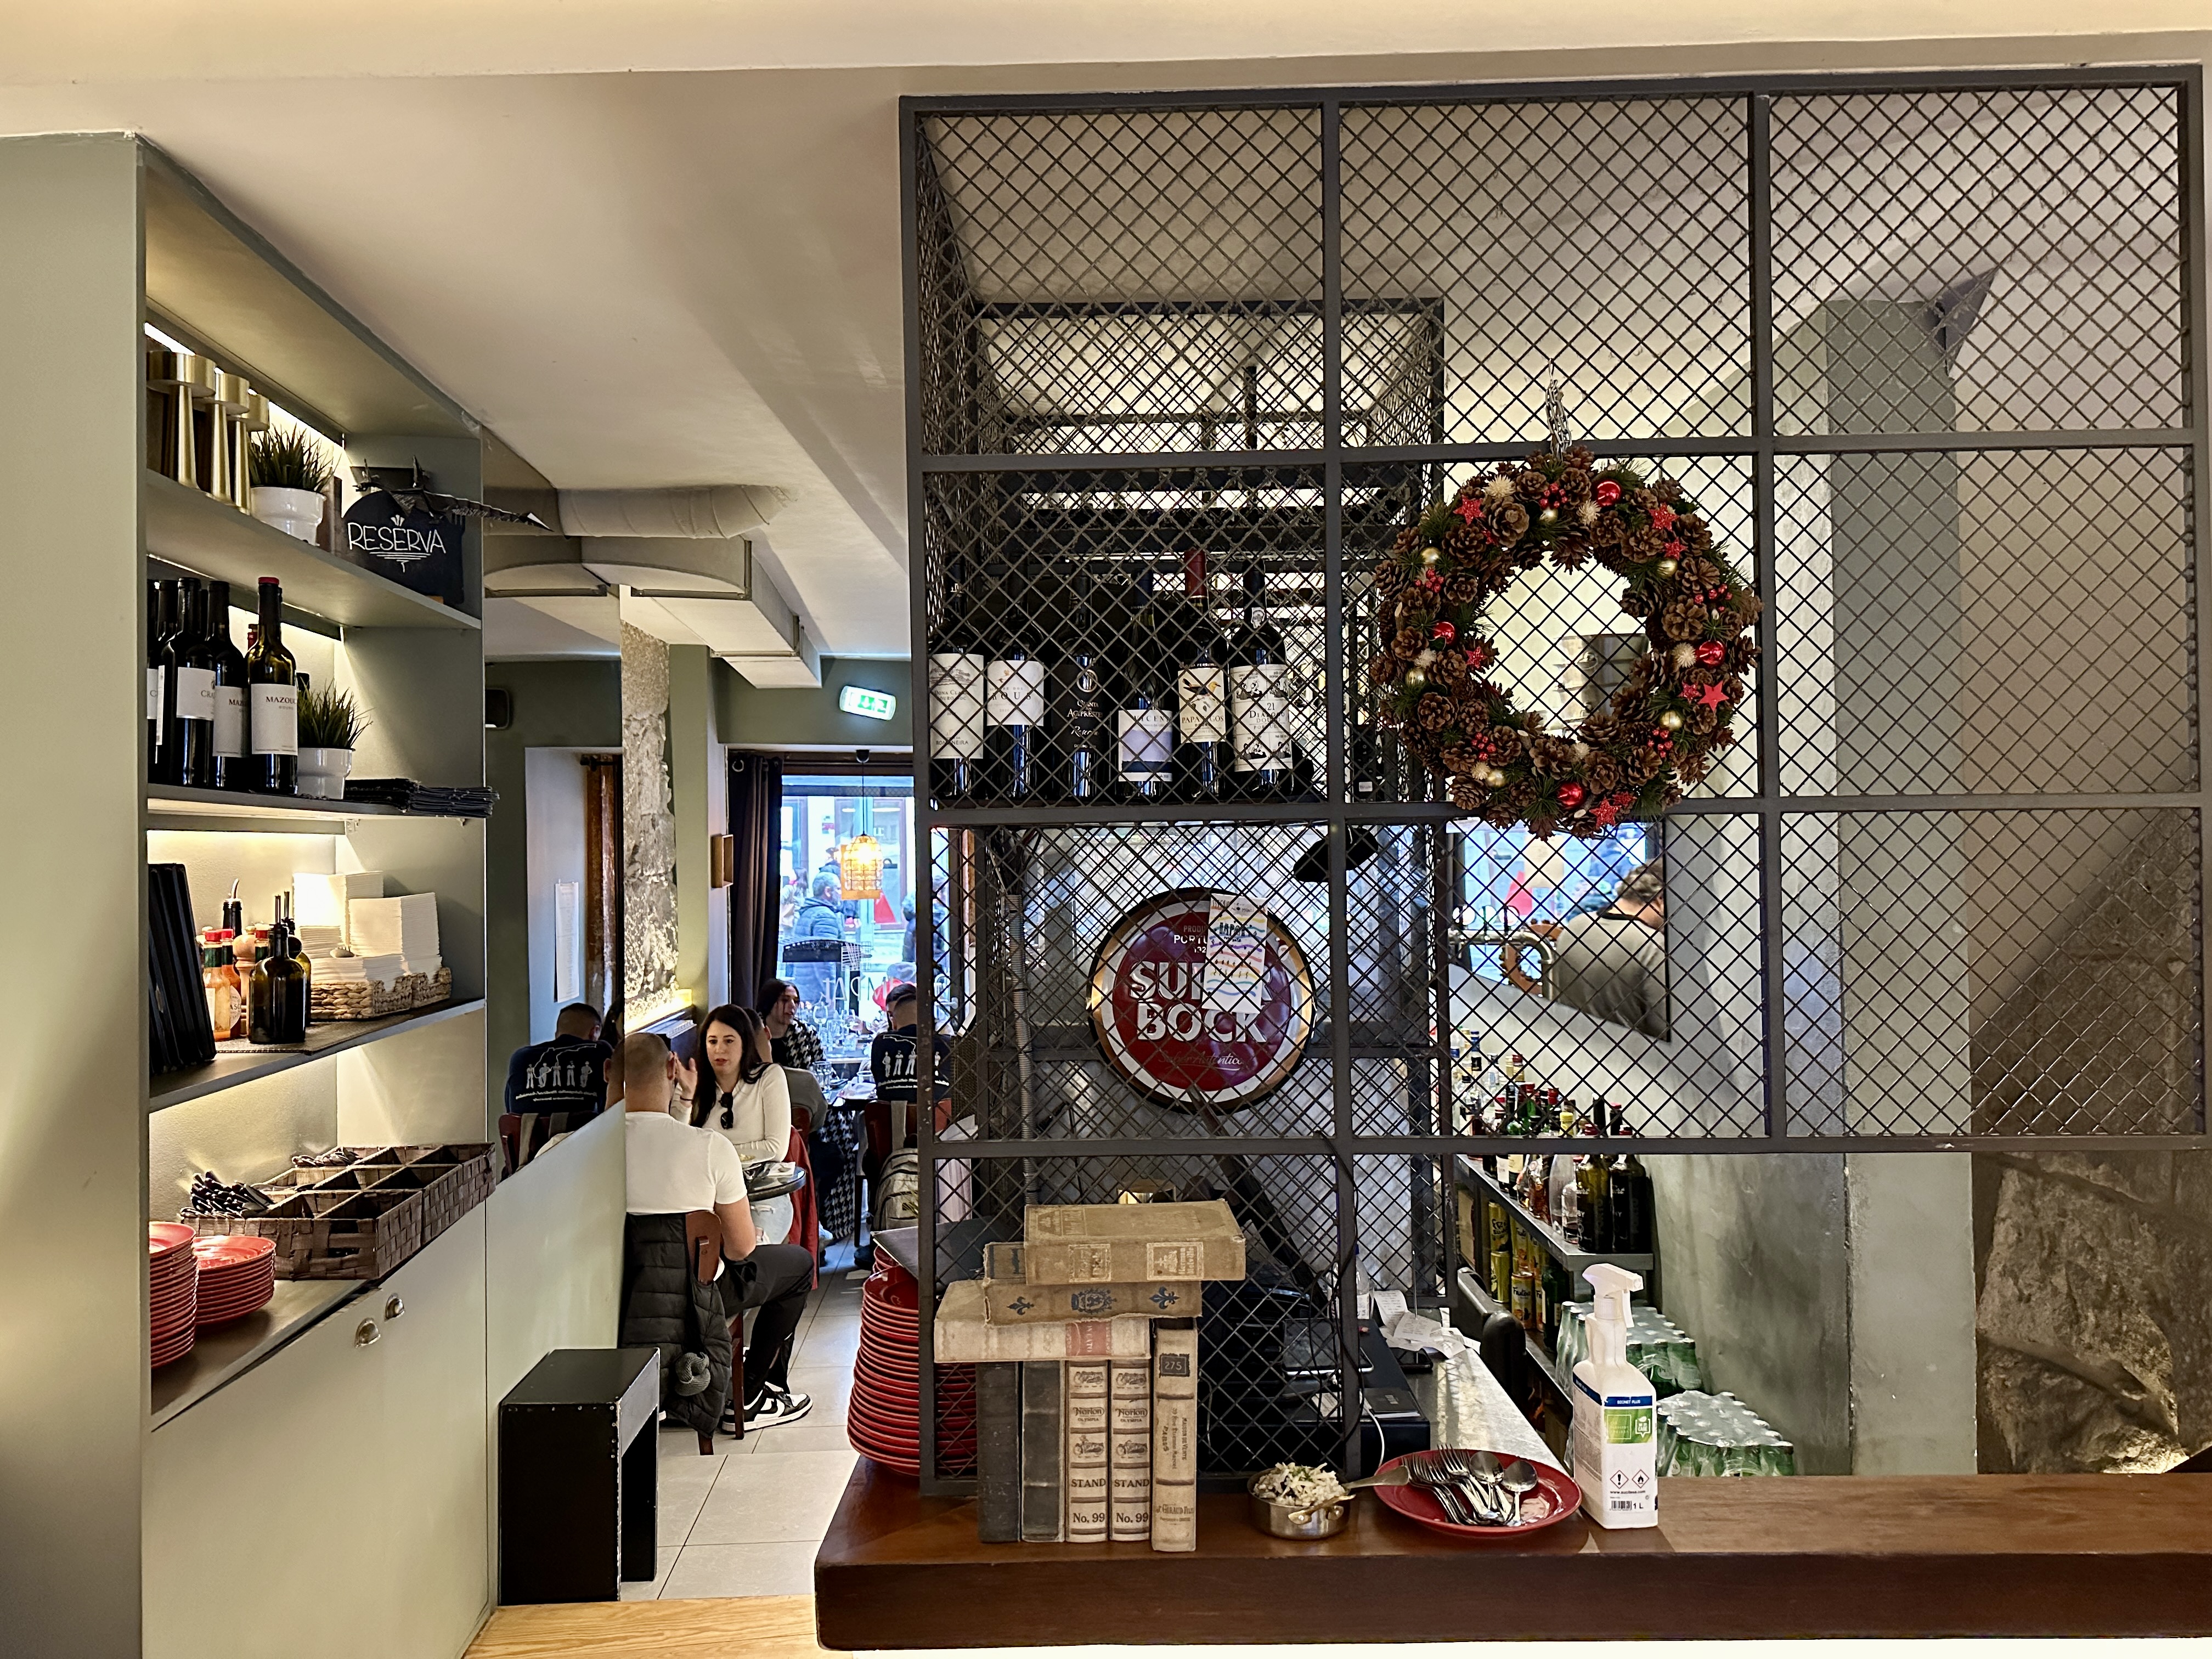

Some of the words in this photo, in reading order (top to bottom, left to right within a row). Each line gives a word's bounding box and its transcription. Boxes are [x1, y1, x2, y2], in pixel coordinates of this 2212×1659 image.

[347, 522, 446, 554] RESERVA
[1267, 702, 1275, 710] 21
[1137, 1000, 1268, 1043] BOCK
[1164, 1361, 1182, 1370] 275
[1073, 1407, 1104, 1417] Norton
[1115, 1408, 1148, 1418] Norton
[1071, 1478, 1106, 1488] STAND
[1114, 1478, 1150, 1488] STAND
[1073, 1513, 1090, 1523] No.
[1091, 1513, 1105, 1523] 99
[1115, 1513, 1133, 1523] No.
[1135, 1512, 1149, 1523] 99
